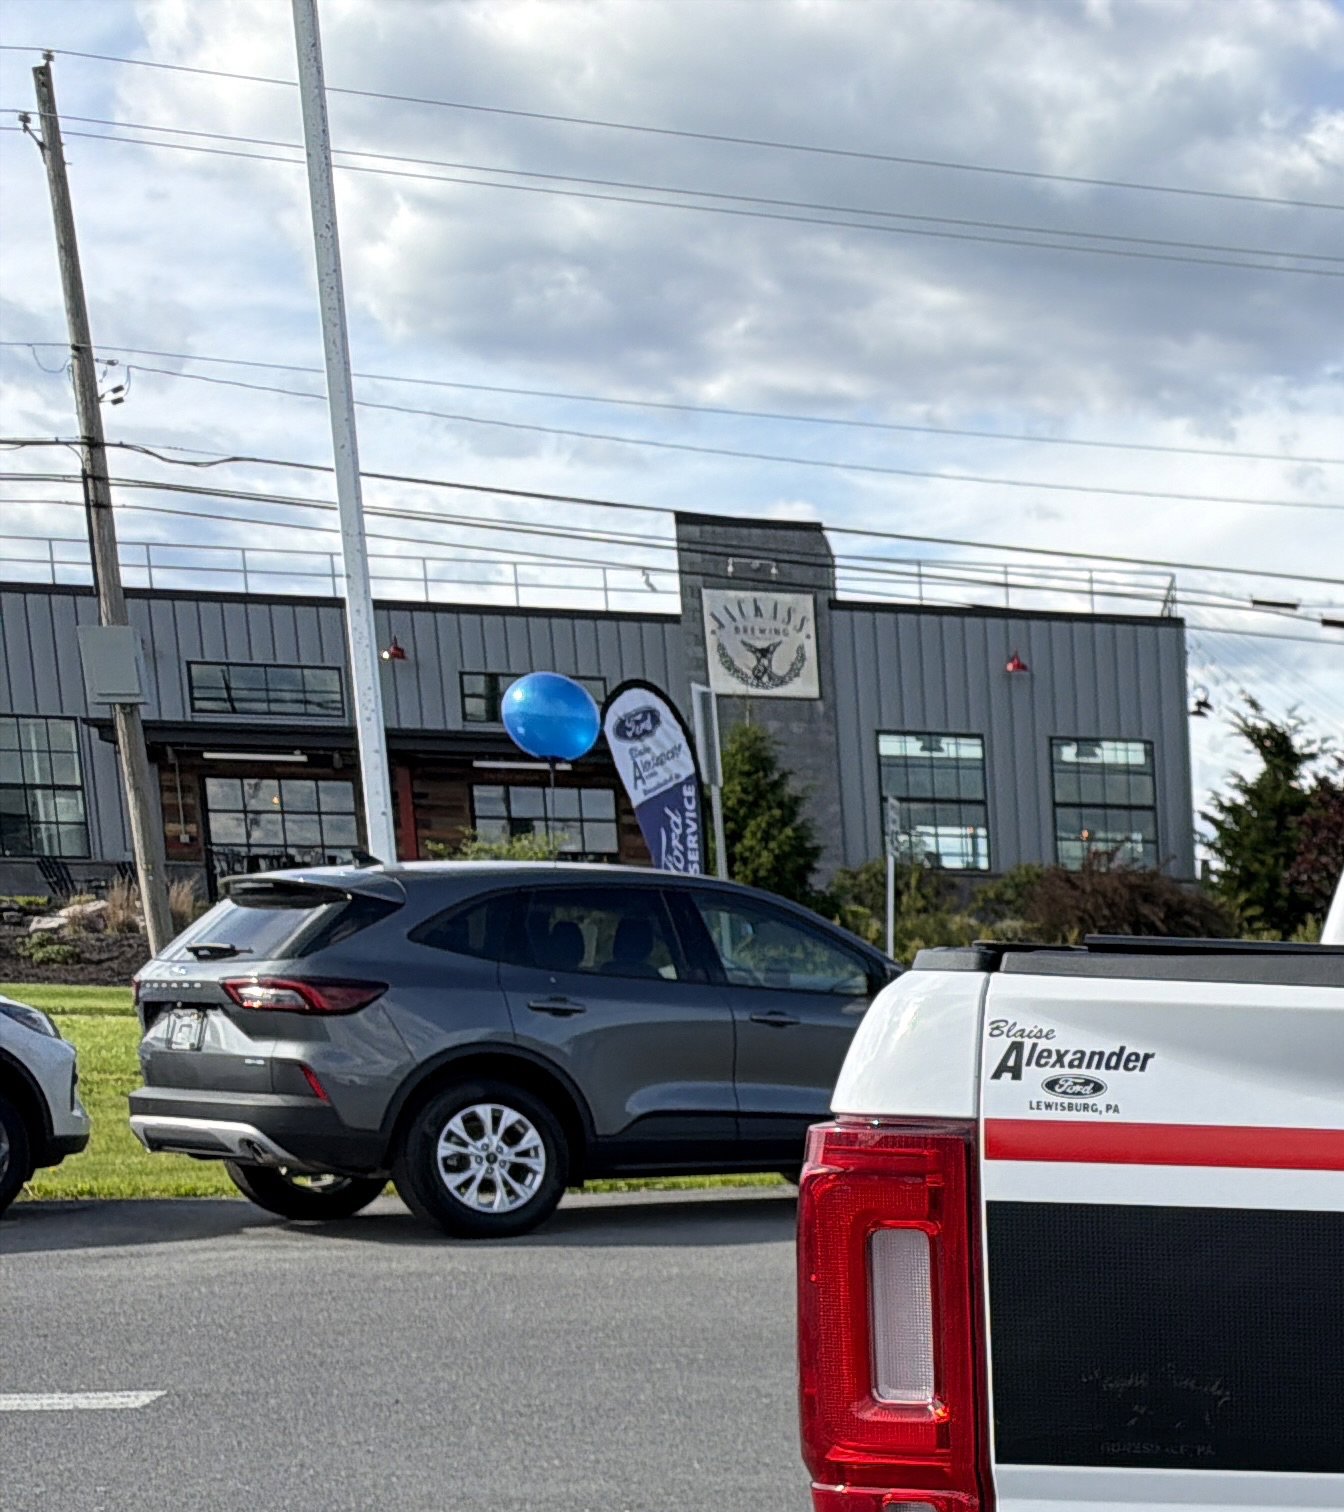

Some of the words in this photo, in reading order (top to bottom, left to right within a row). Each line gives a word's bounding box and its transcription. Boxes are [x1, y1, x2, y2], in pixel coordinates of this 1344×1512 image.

[682, 783, 700, 876] SERVICE
[989, 1019, 1056, 1040] Blaise
[990, 1041, 1156, 1081] Alexander
[1055, 1077, 1094, 1095] Ford
[1029, 1100, 1103, 1115] LEWISBURG,
[1105, 1103, 1121, 1114] PA
